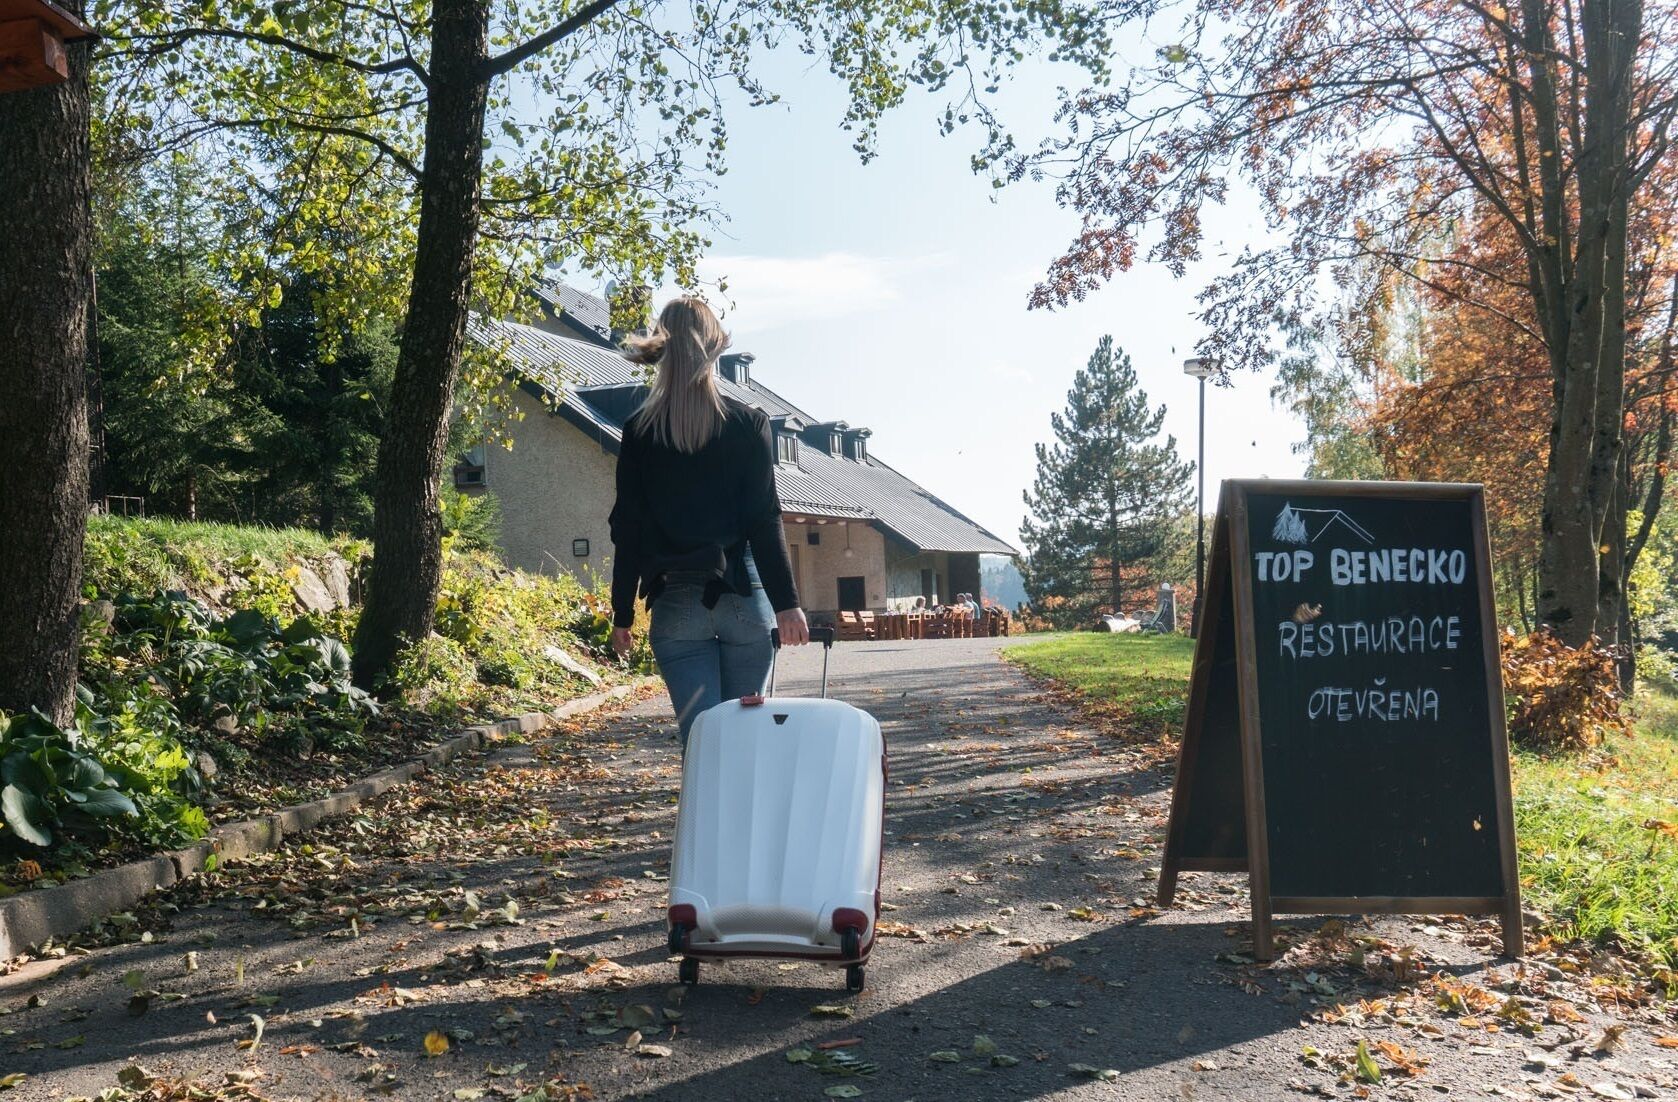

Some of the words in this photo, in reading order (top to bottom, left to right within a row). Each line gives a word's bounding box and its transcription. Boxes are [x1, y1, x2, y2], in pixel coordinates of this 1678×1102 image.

[1255, 551, 1314, 582] TOP
[1330, 548, 1466, 585] BENECKO
[1279, 616, 1461, 659] RESTAURACE
[1308, 677, 1439, 722] OTEVŘENA
